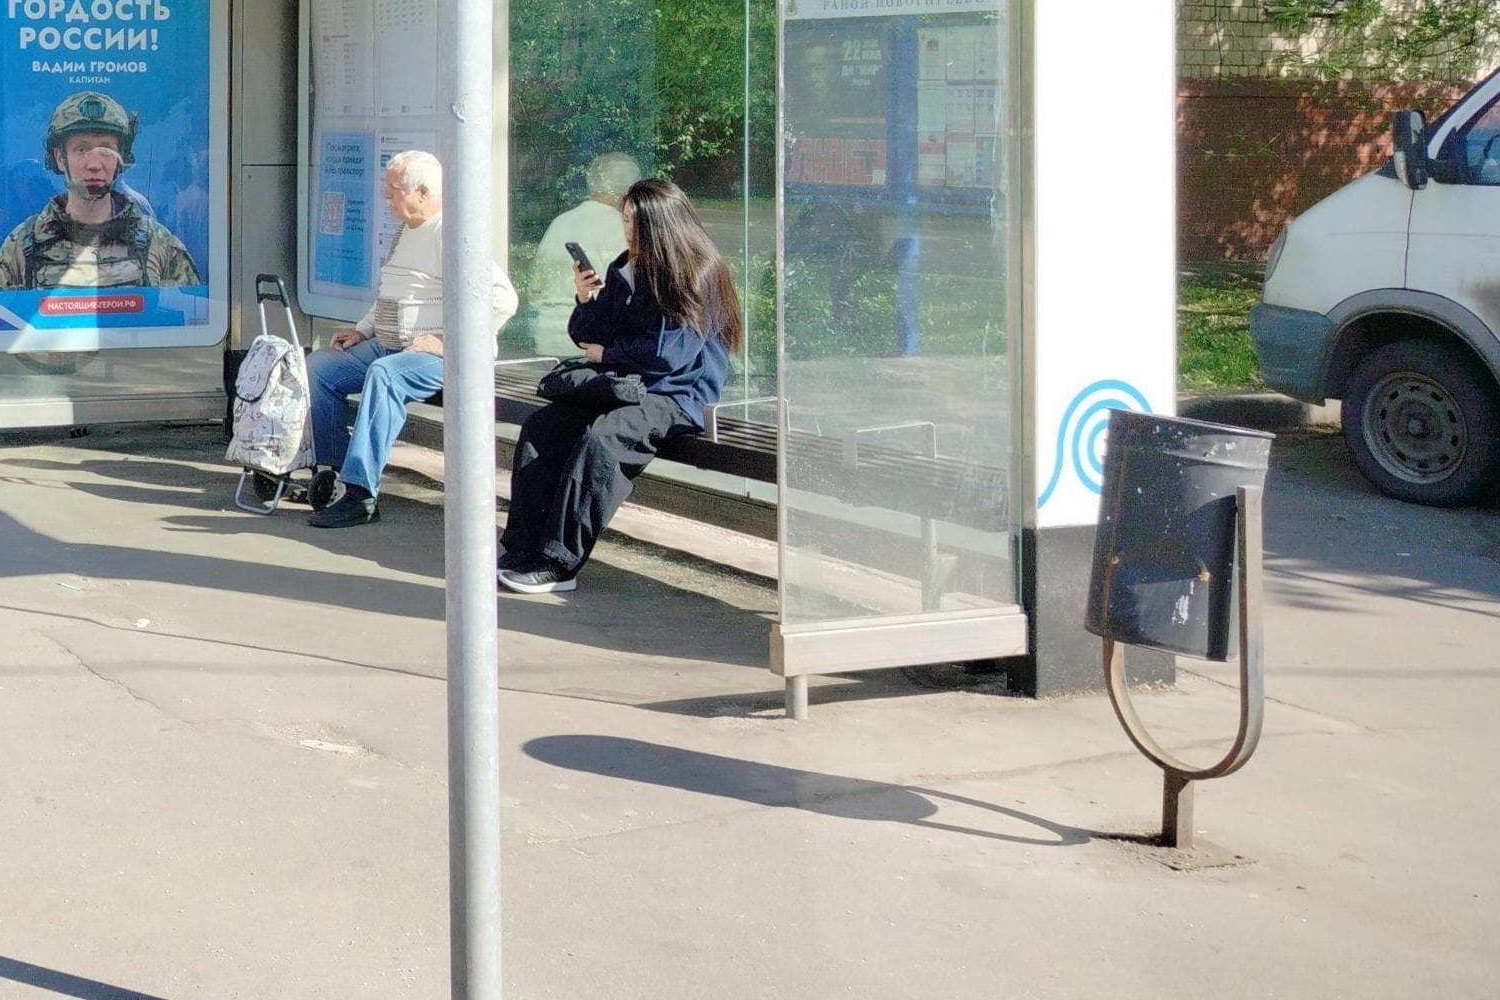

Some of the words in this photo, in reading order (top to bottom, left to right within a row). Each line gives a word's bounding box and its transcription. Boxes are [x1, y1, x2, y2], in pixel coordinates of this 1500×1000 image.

[19, 26, 159, 51] РОССИИ!
[32, 60, 86, 73] ВАДИМ
[90, 61, 147, 73] ГРОМОВ
[68, 75, 111, 85] КАПИТАН
